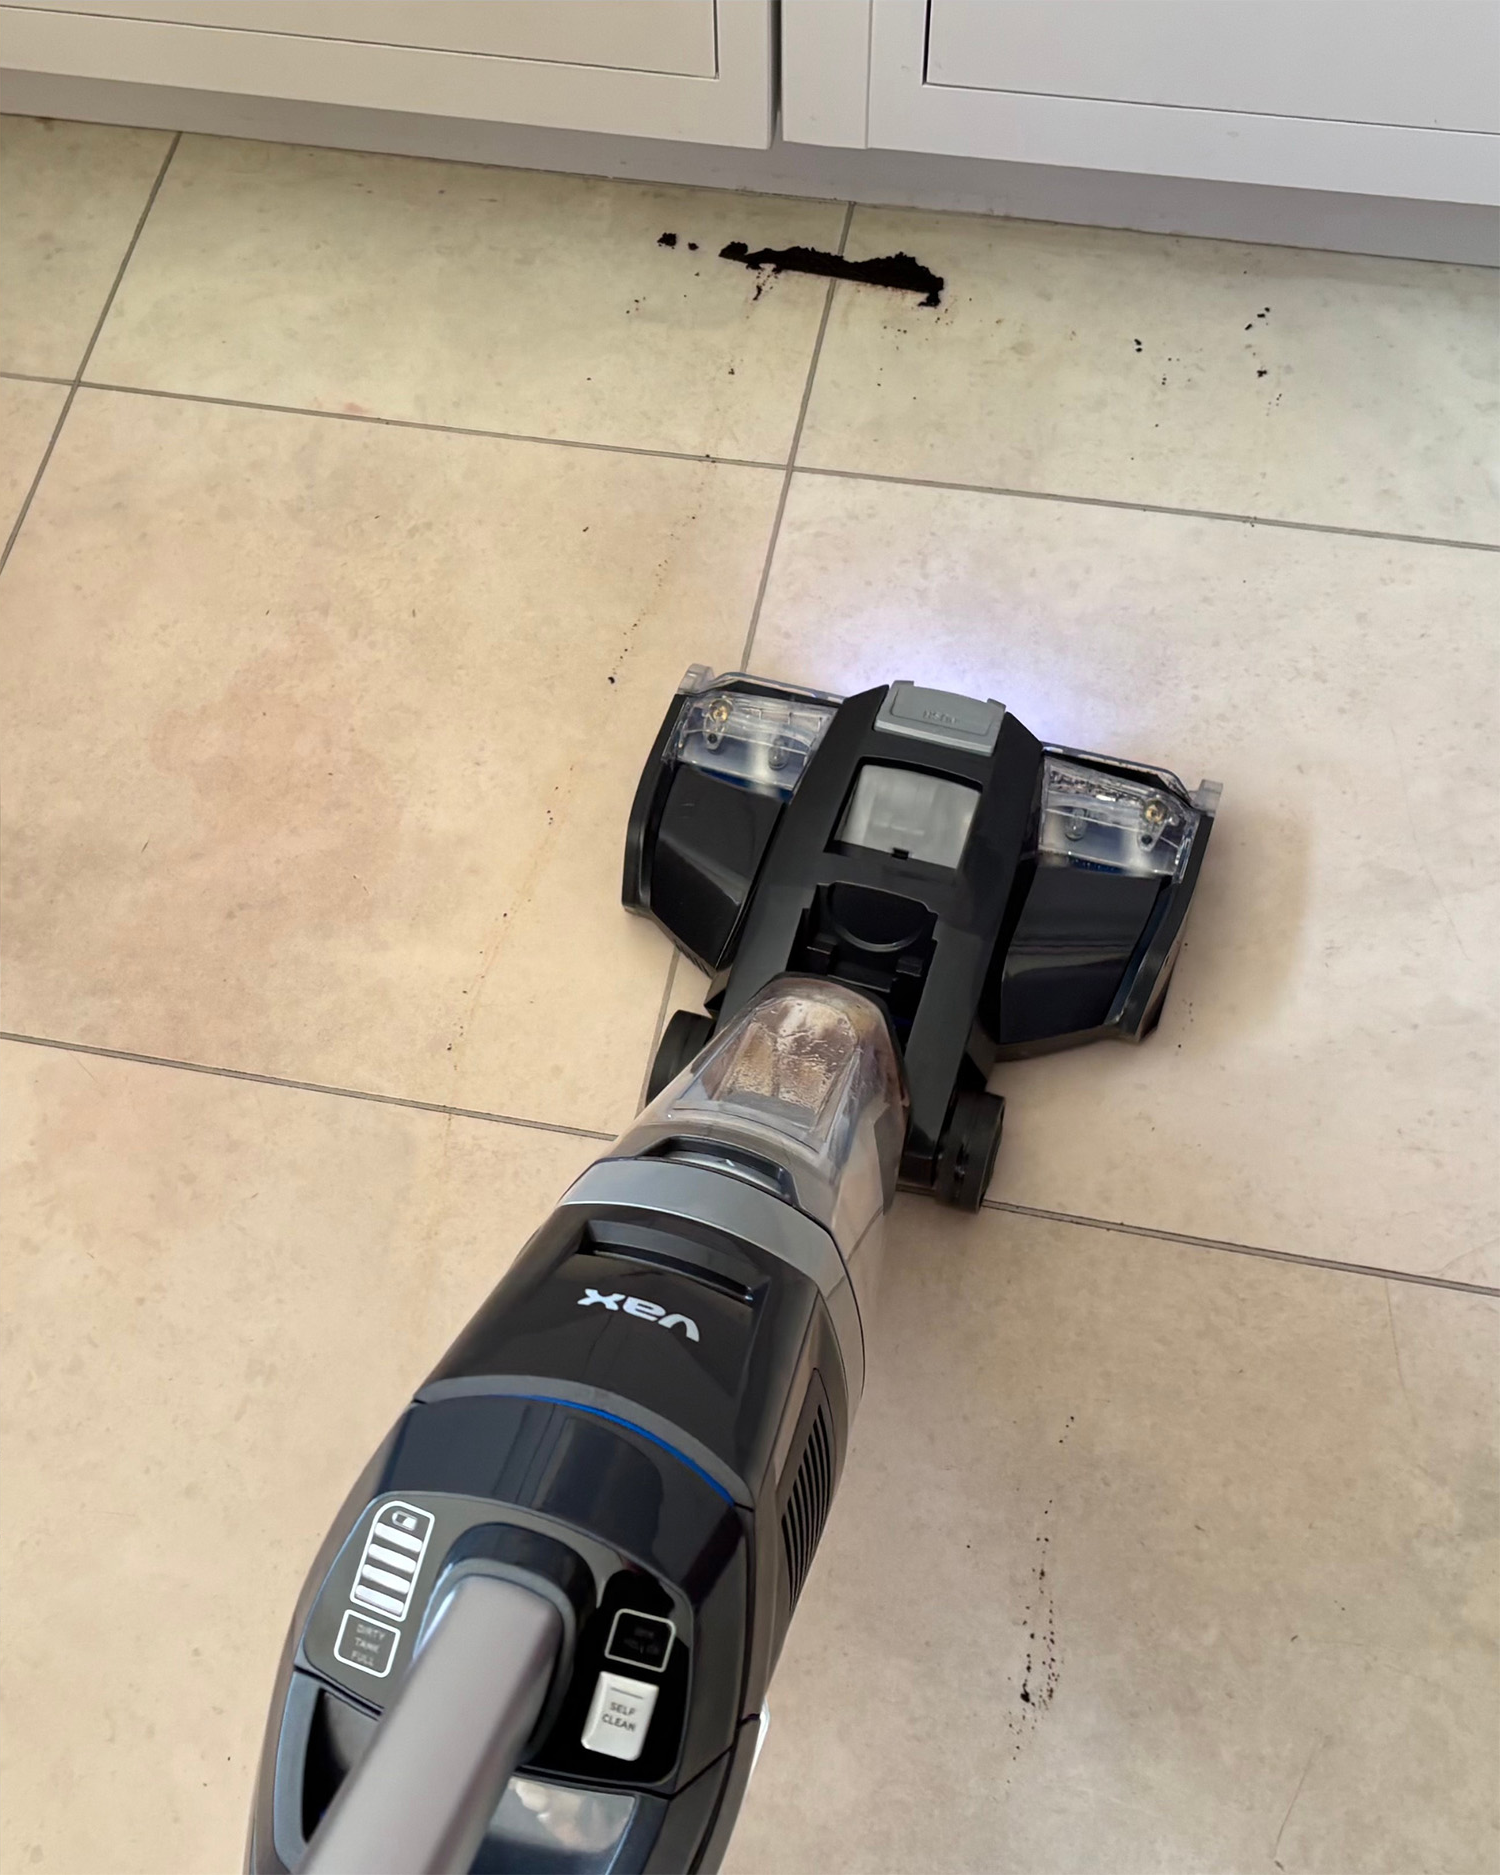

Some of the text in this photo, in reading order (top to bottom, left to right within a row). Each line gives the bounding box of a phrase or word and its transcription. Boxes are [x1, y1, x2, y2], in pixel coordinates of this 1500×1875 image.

[356, 1623, 386, 1641] DIRTY
[354, 1636, 380, 1654] TANK
[350, 1650, 375, 1667] FULL
[610, 1701, 636, 1716] SELF
[601, 1713, 636, 1732] CLEAN
